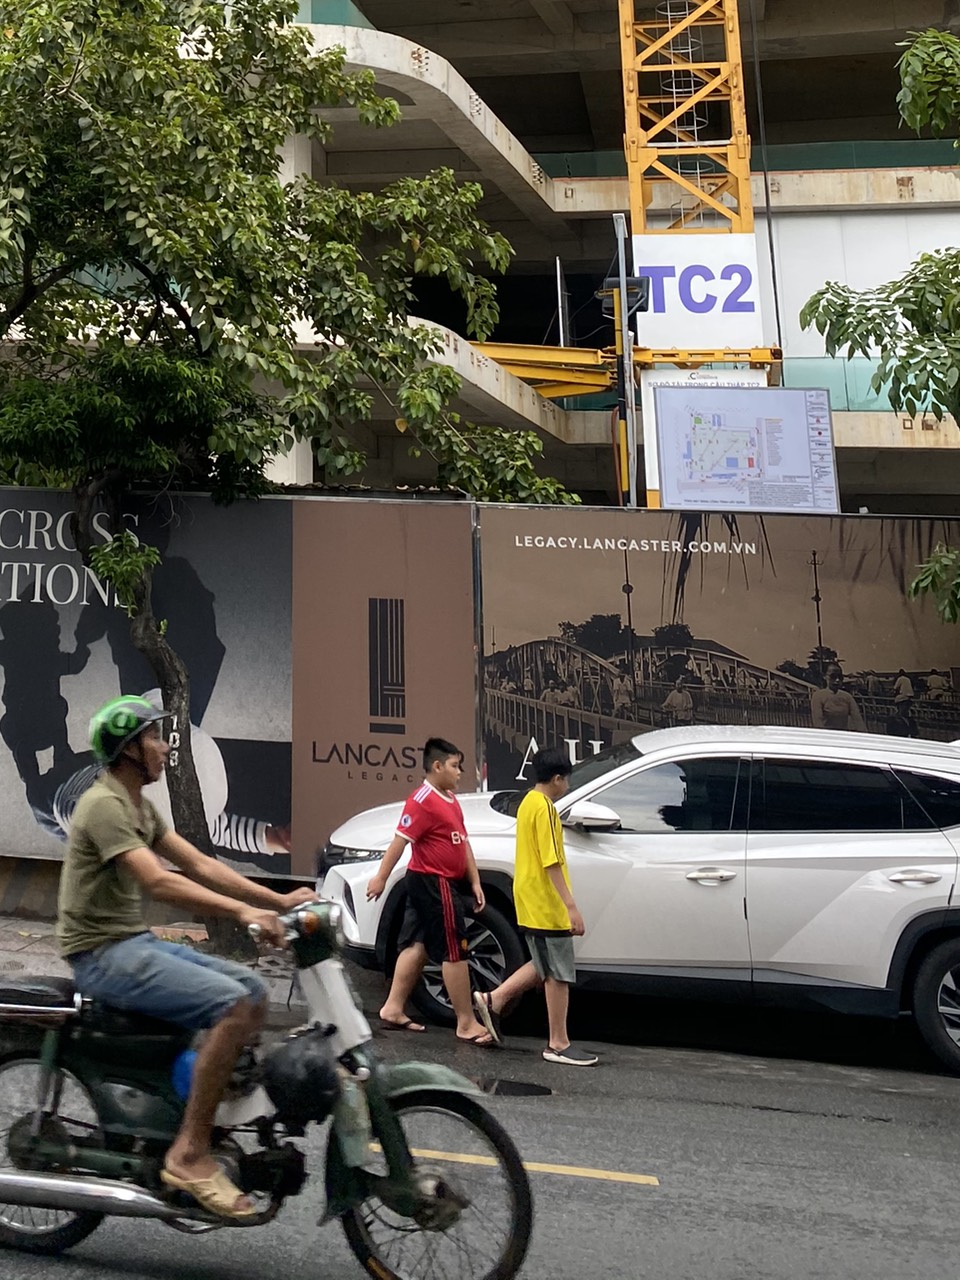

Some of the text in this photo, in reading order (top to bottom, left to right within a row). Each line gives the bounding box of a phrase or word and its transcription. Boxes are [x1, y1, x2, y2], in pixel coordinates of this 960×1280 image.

[639, 264, 755, 313] TC2
[515, 535, 757, 555] LEGACY.LANCASTER.COM.VN
[312, 740, 465, 773] LANCAS
[347, 771, 425, 784] LEGAC
